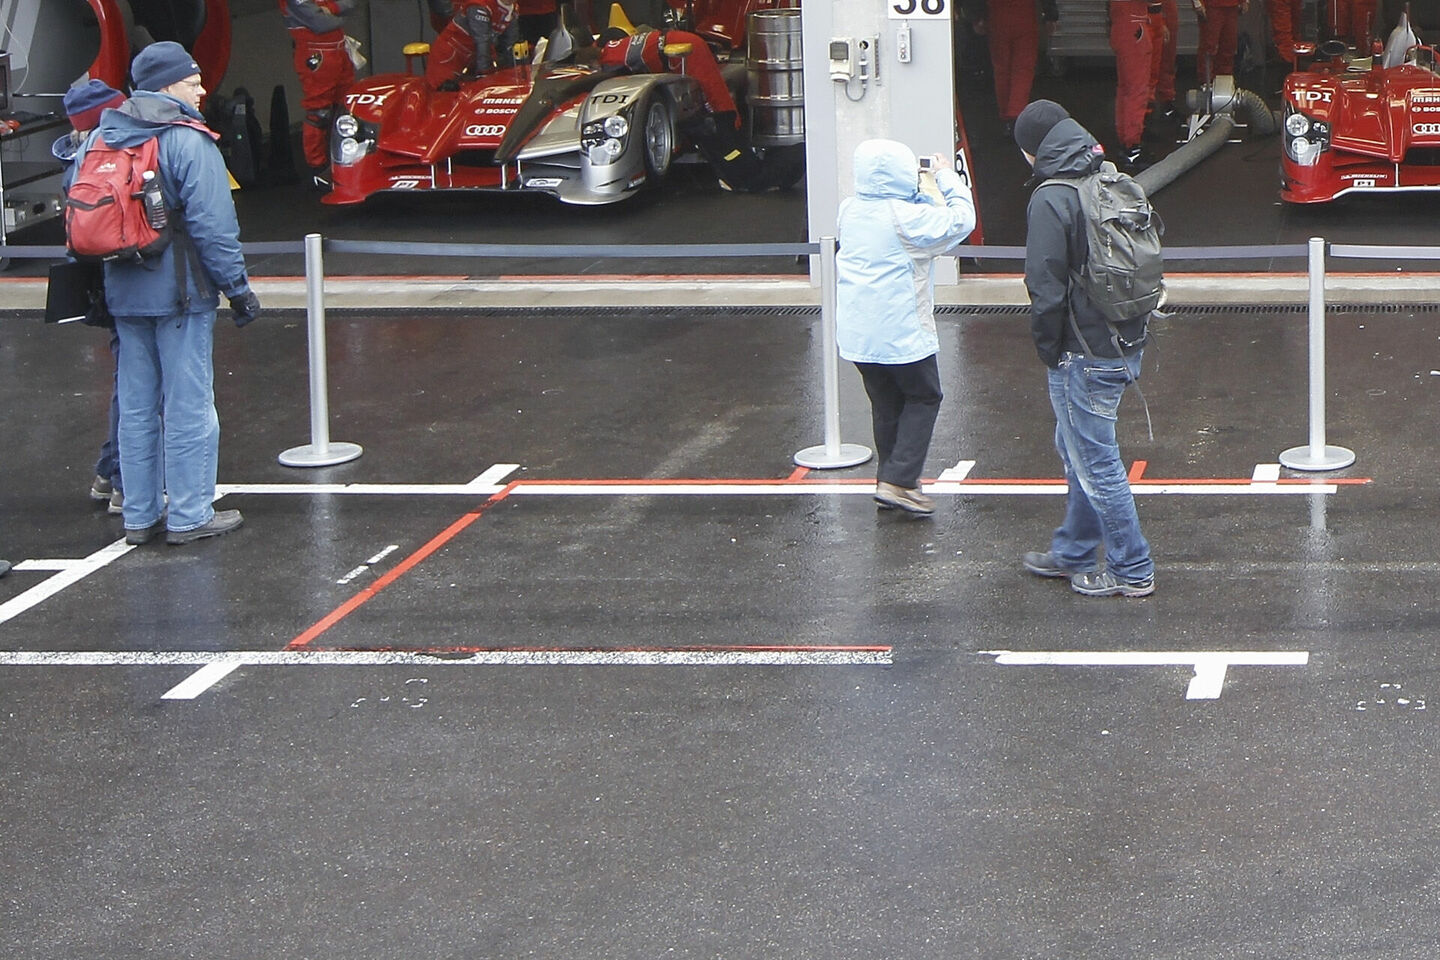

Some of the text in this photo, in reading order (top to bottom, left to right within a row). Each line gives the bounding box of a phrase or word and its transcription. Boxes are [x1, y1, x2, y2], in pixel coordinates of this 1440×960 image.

[345, 94, 387, 106] TDI
[591, 94, 630, 105] TDI
[1291, 91, 1332, 103] TDI
